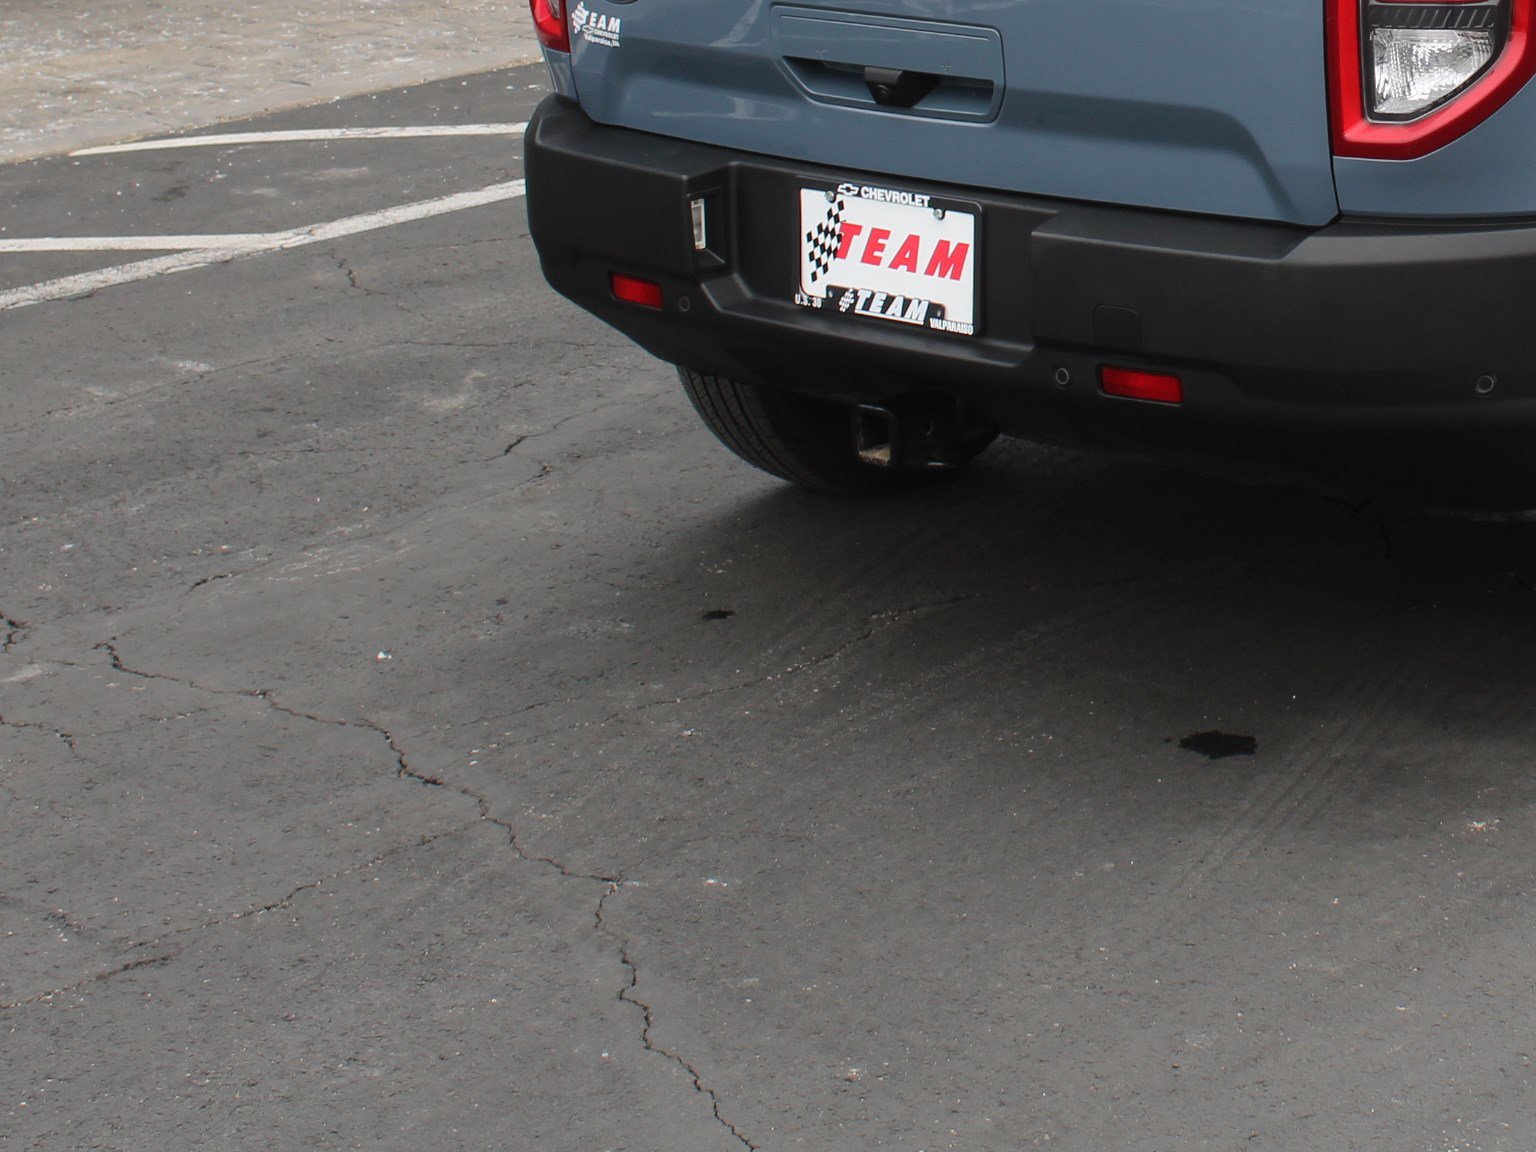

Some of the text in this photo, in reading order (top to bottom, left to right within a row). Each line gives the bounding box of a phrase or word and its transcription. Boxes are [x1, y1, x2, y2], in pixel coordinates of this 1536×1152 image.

[860, 186, 931, 208] CHEVROLET
[836, 221, 970, 281] TEAM
[854, 288, 930, 325] TEAM
[929, 317, 974, 336] VALPARAISO
